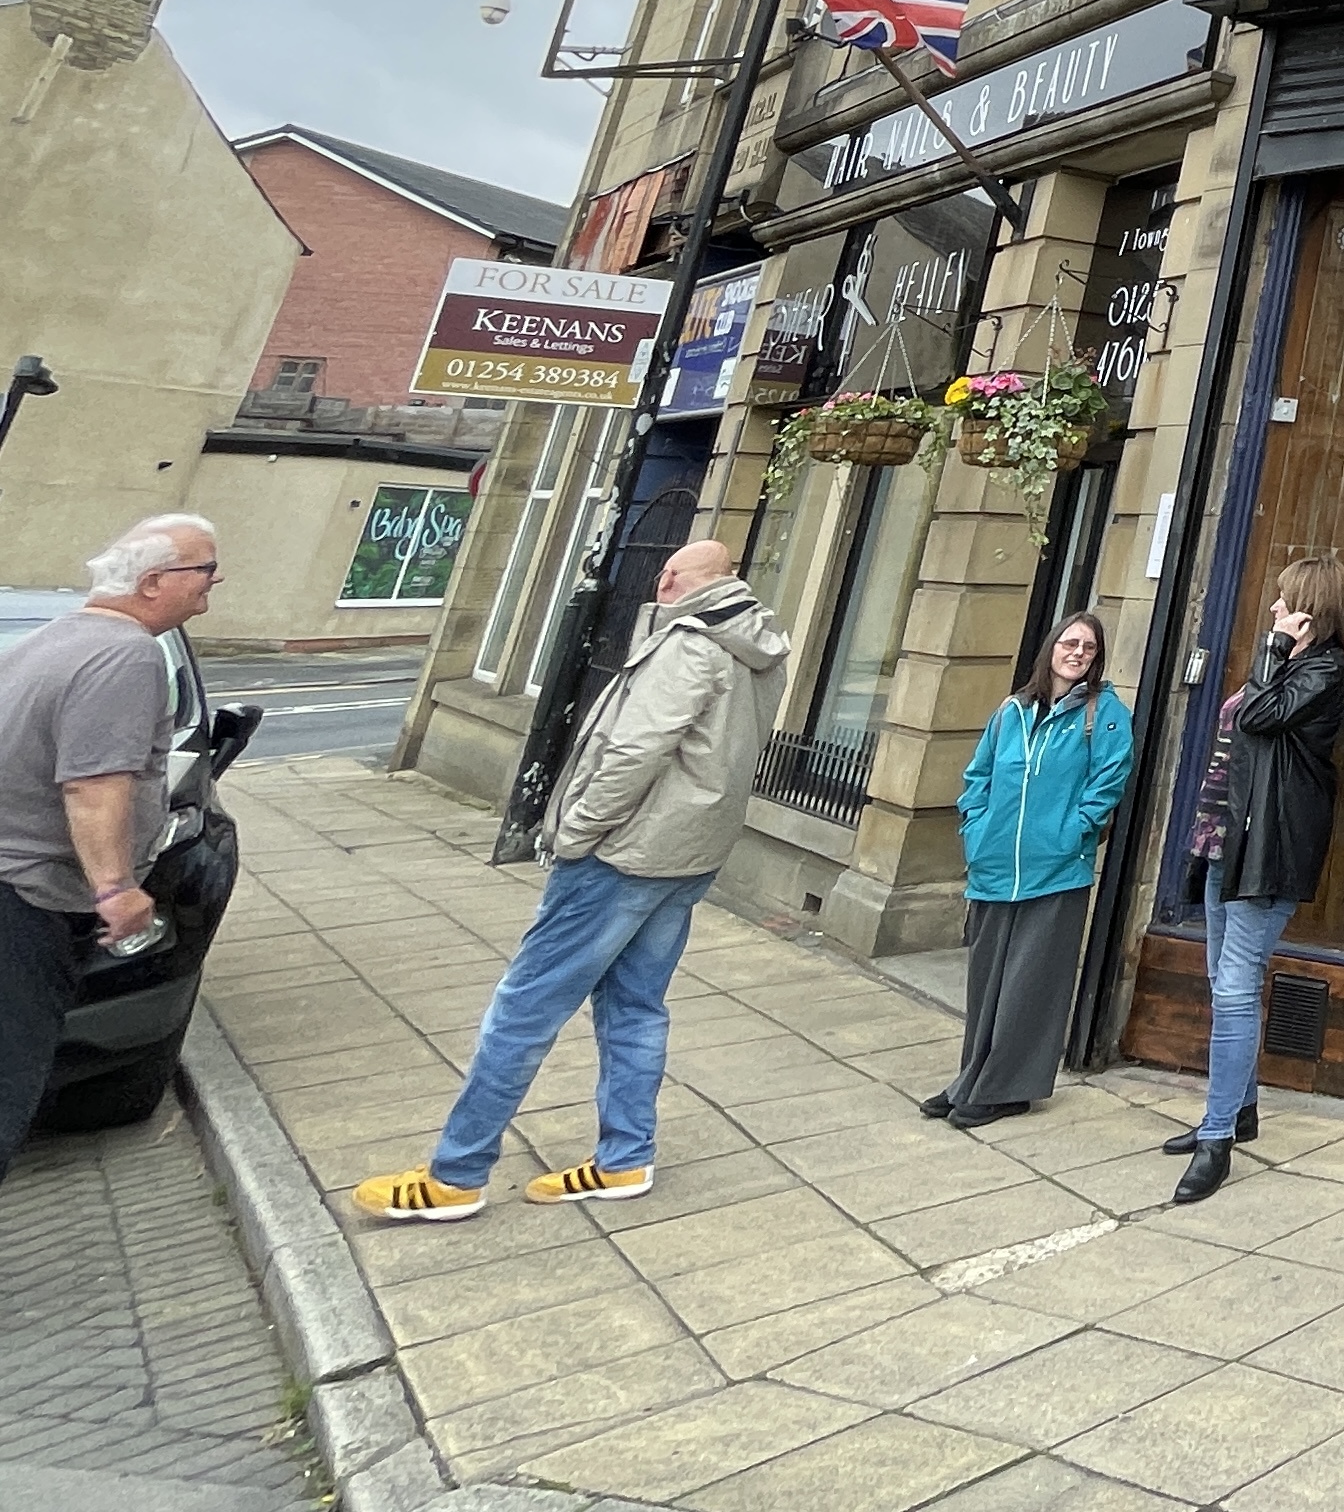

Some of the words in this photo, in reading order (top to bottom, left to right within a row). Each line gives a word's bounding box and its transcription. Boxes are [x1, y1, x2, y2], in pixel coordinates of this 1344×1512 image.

[968, 84, 992, 137] &
[1007, 33, 1119, 124] BEAUTY
[475, 266, 552, 294] FOR
[562, 275, 648, 305] SALE
[472, 307, 626, 344] KEENANS
[493, 334, 528, 349] Sales
[530, 338, 541, 349] &
[543, 340, 595, 355] Lettings
[446, 358, 526, 381] 01254
[529, 365, 620, 389] 389384
[371, 506, 425, 561] Baby
[421, 503, 461, 548] Spa
